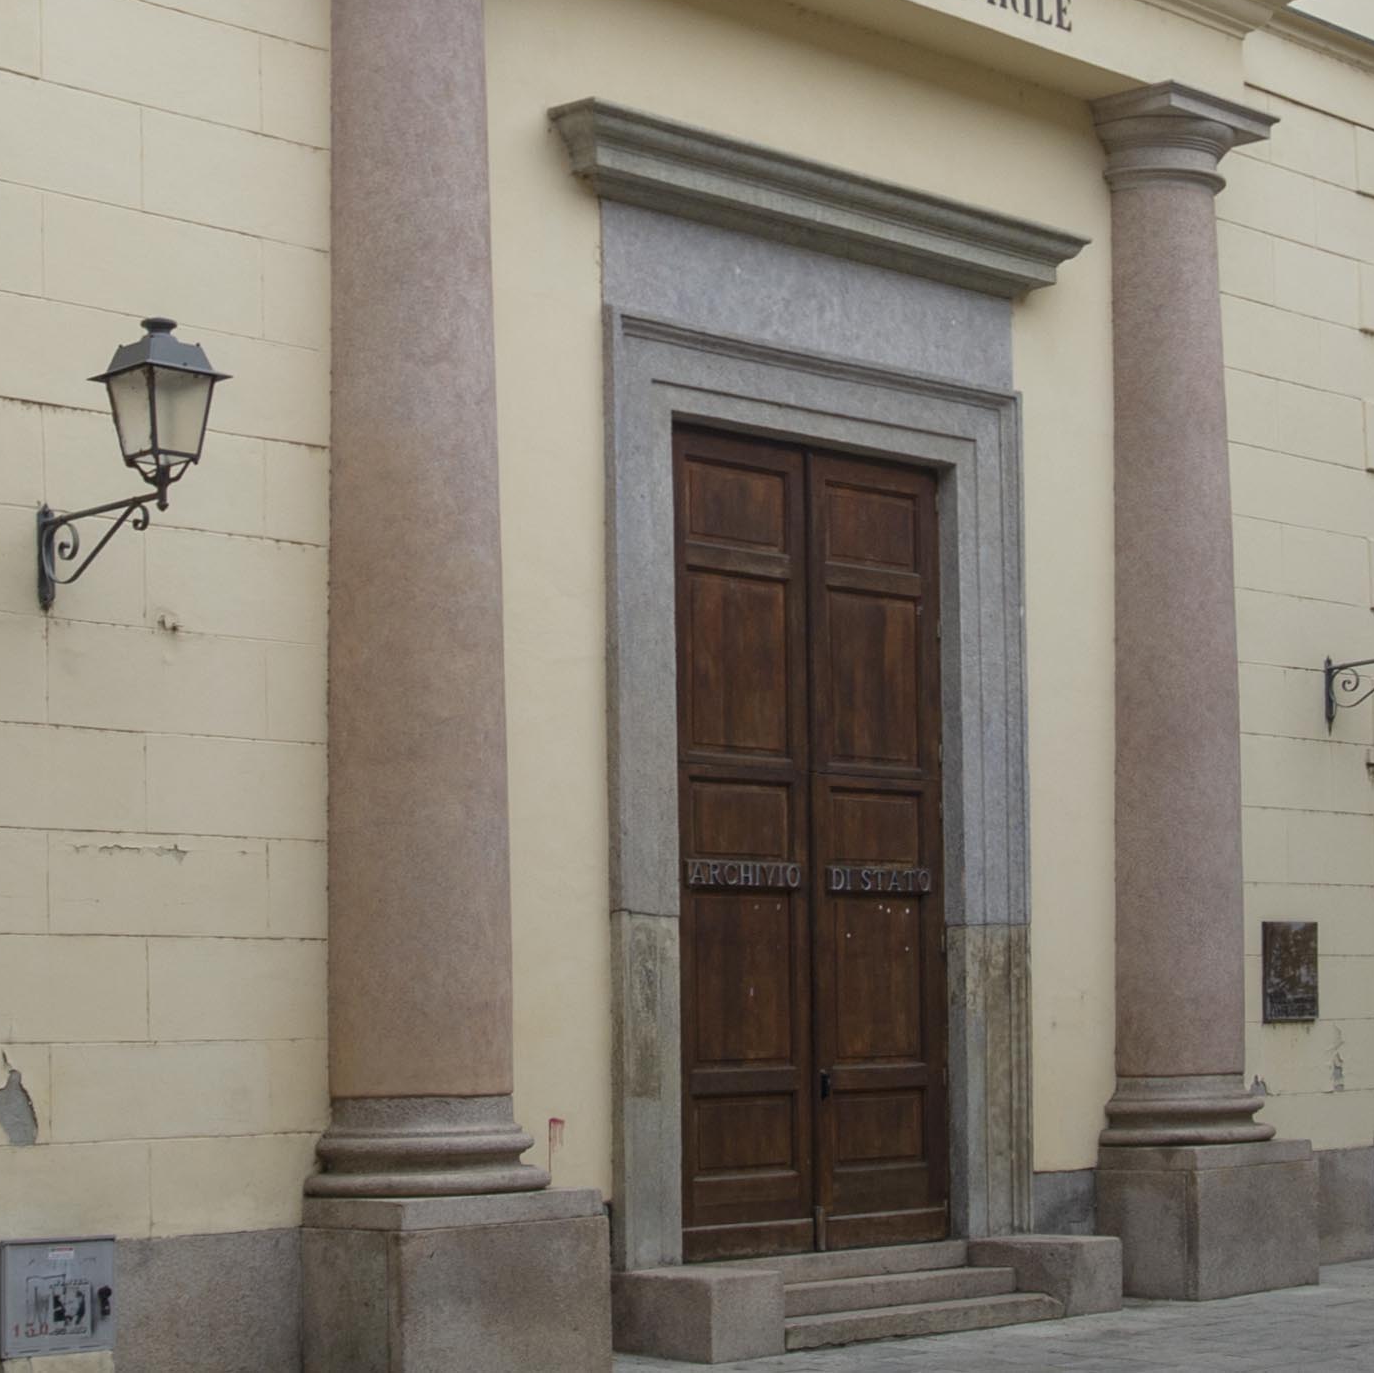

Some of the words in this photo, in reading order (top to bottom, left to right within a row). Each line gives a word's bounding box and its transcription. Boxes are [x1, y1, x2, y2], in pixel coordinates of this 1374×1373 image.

[688, 861, 801, 888] ARCHIVIO
[830, 867, 852, 891] DI
[860, 868, 932, 892] STATO
